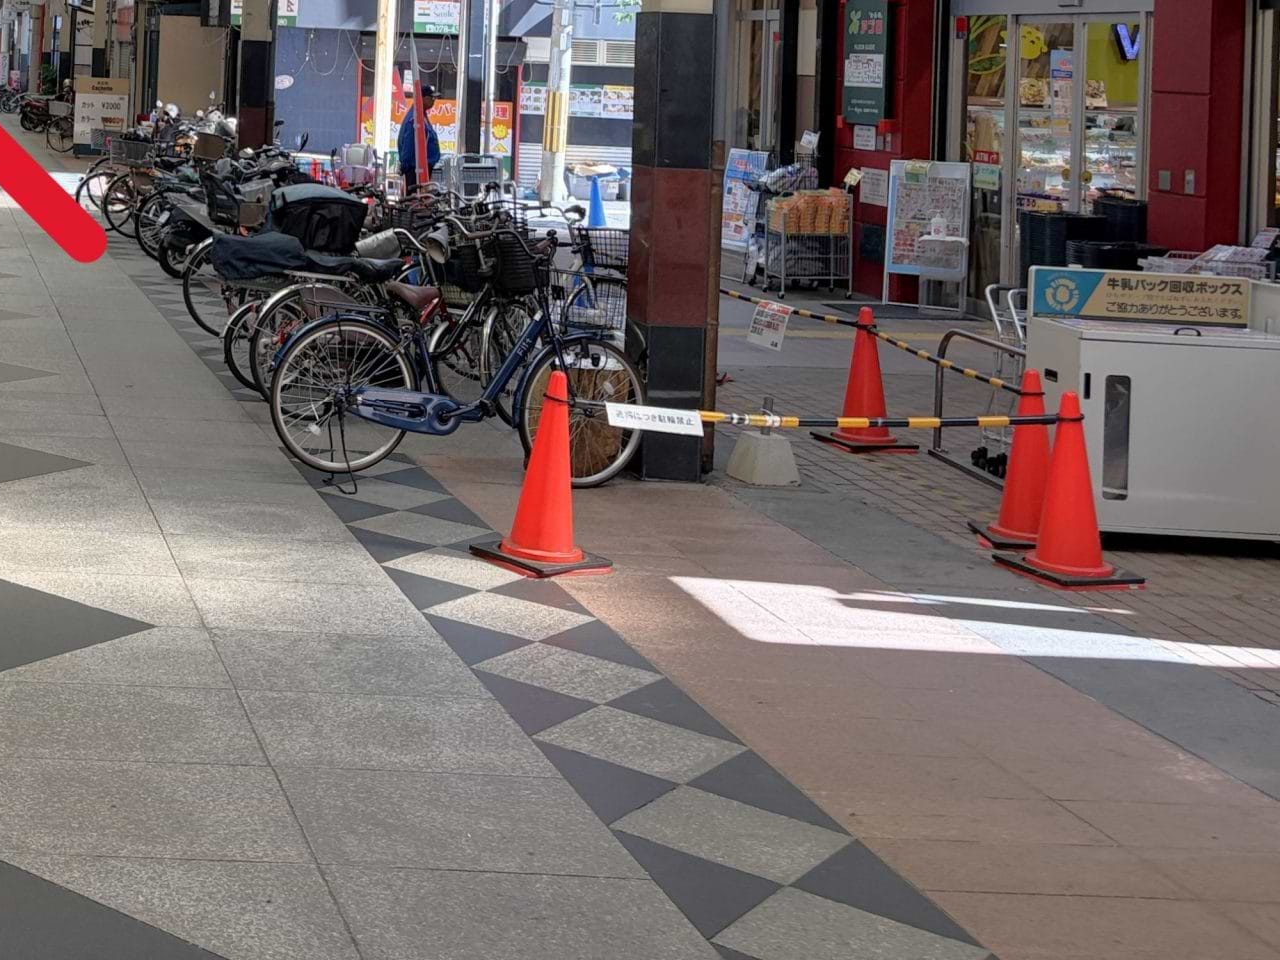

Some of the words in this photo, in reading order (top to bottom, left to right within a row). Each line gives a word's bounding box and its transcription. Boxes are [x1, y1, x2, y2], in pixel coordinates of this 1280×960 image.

[1106, 277, 1244, 296] 牛乳パック回収ボックス
[1105, 301, 1243, 320] ご協力ありがとうございます。
